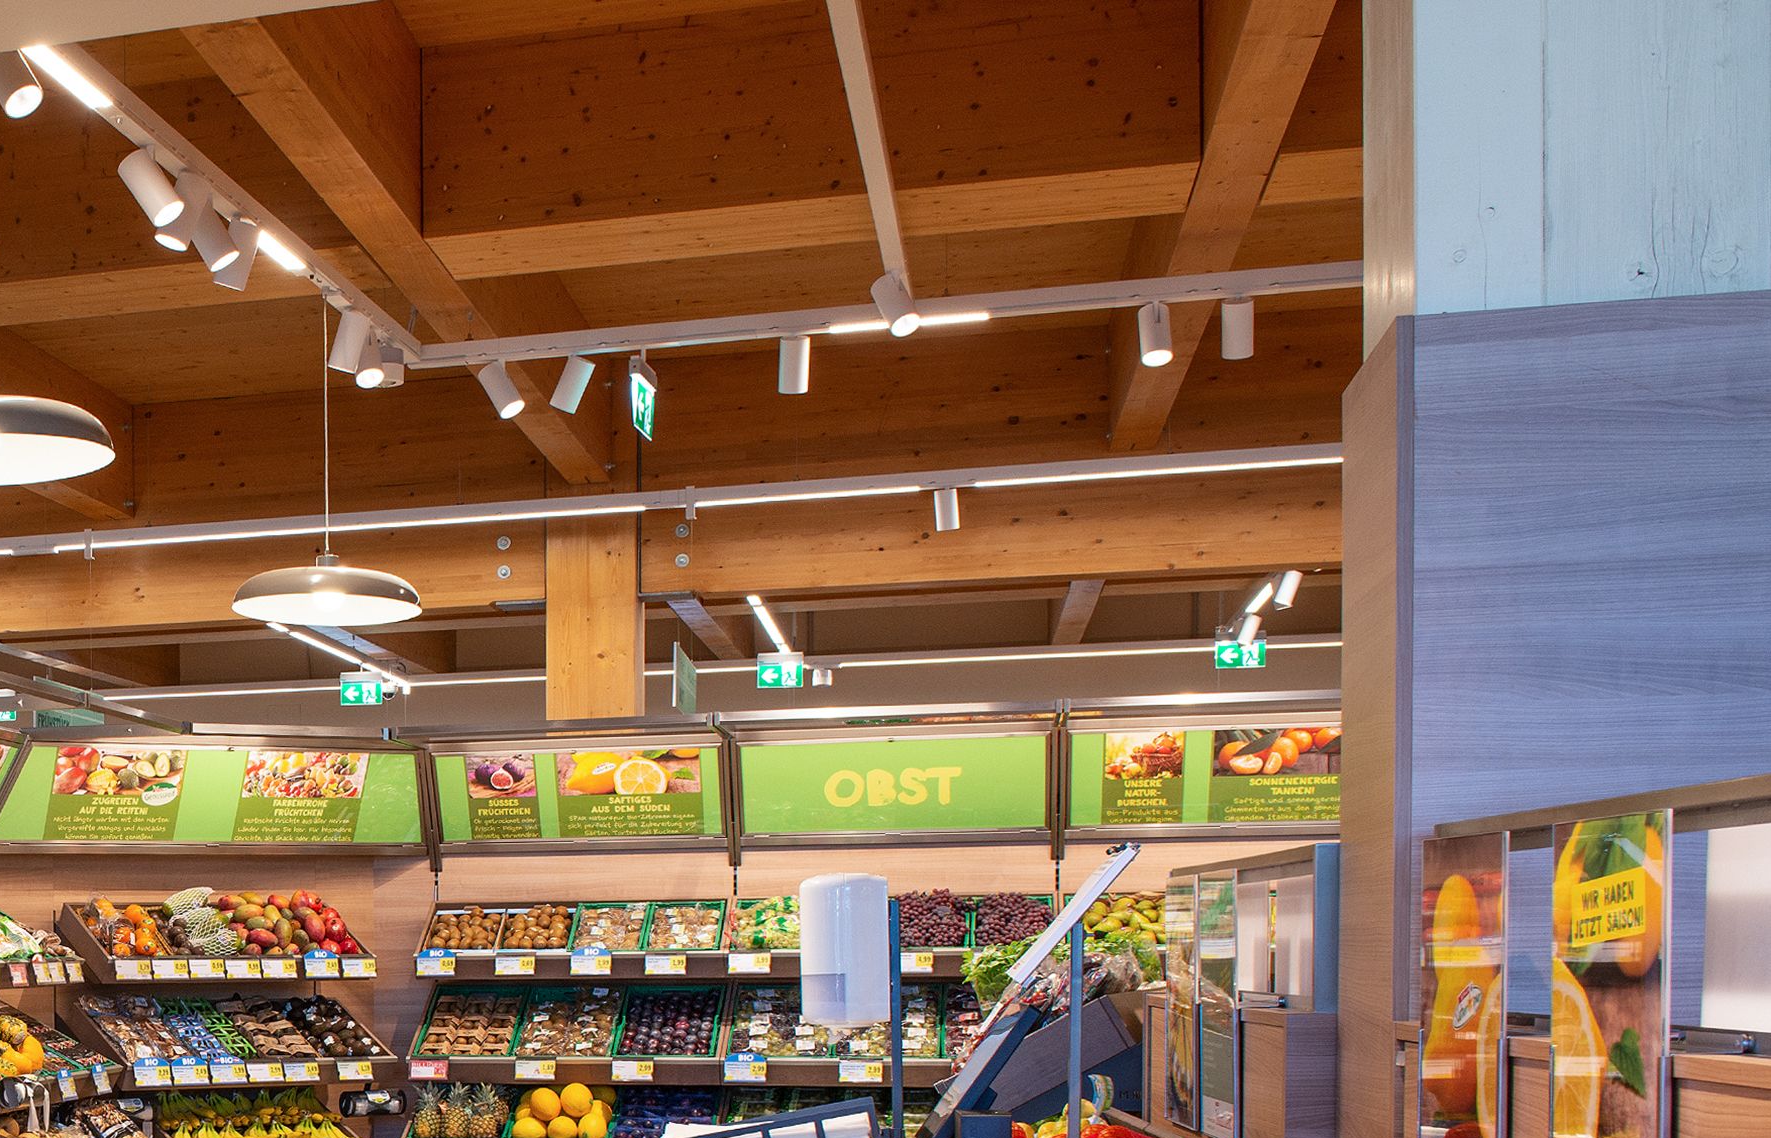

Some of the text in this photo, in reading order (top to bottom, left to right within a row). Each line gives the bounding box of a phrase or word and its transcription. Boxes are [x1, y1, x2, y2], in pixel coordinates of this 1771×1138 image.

[1124, 779, 1162, 787] UNSERE
[1249, 776, 1338, 786] SONNENENERGIE
[824, 767, 962, 807] OBST
[1125, 789, 1161, 797] NATUR-
[92, 797, 139, 805] ZUGREIFEN
[609, 796, 651, 804] SAFTIGES
[274, 808, 324, 816] FRÜCHTCHEN
[478, 808, 531, 816] FRÜCHTCHEN
[640, 804, 671, 812] SÜDEN
[1582, 880, 1634, 911] WIR HABEN
[1574, 906, 1643, 939] JETZT SAISON!
